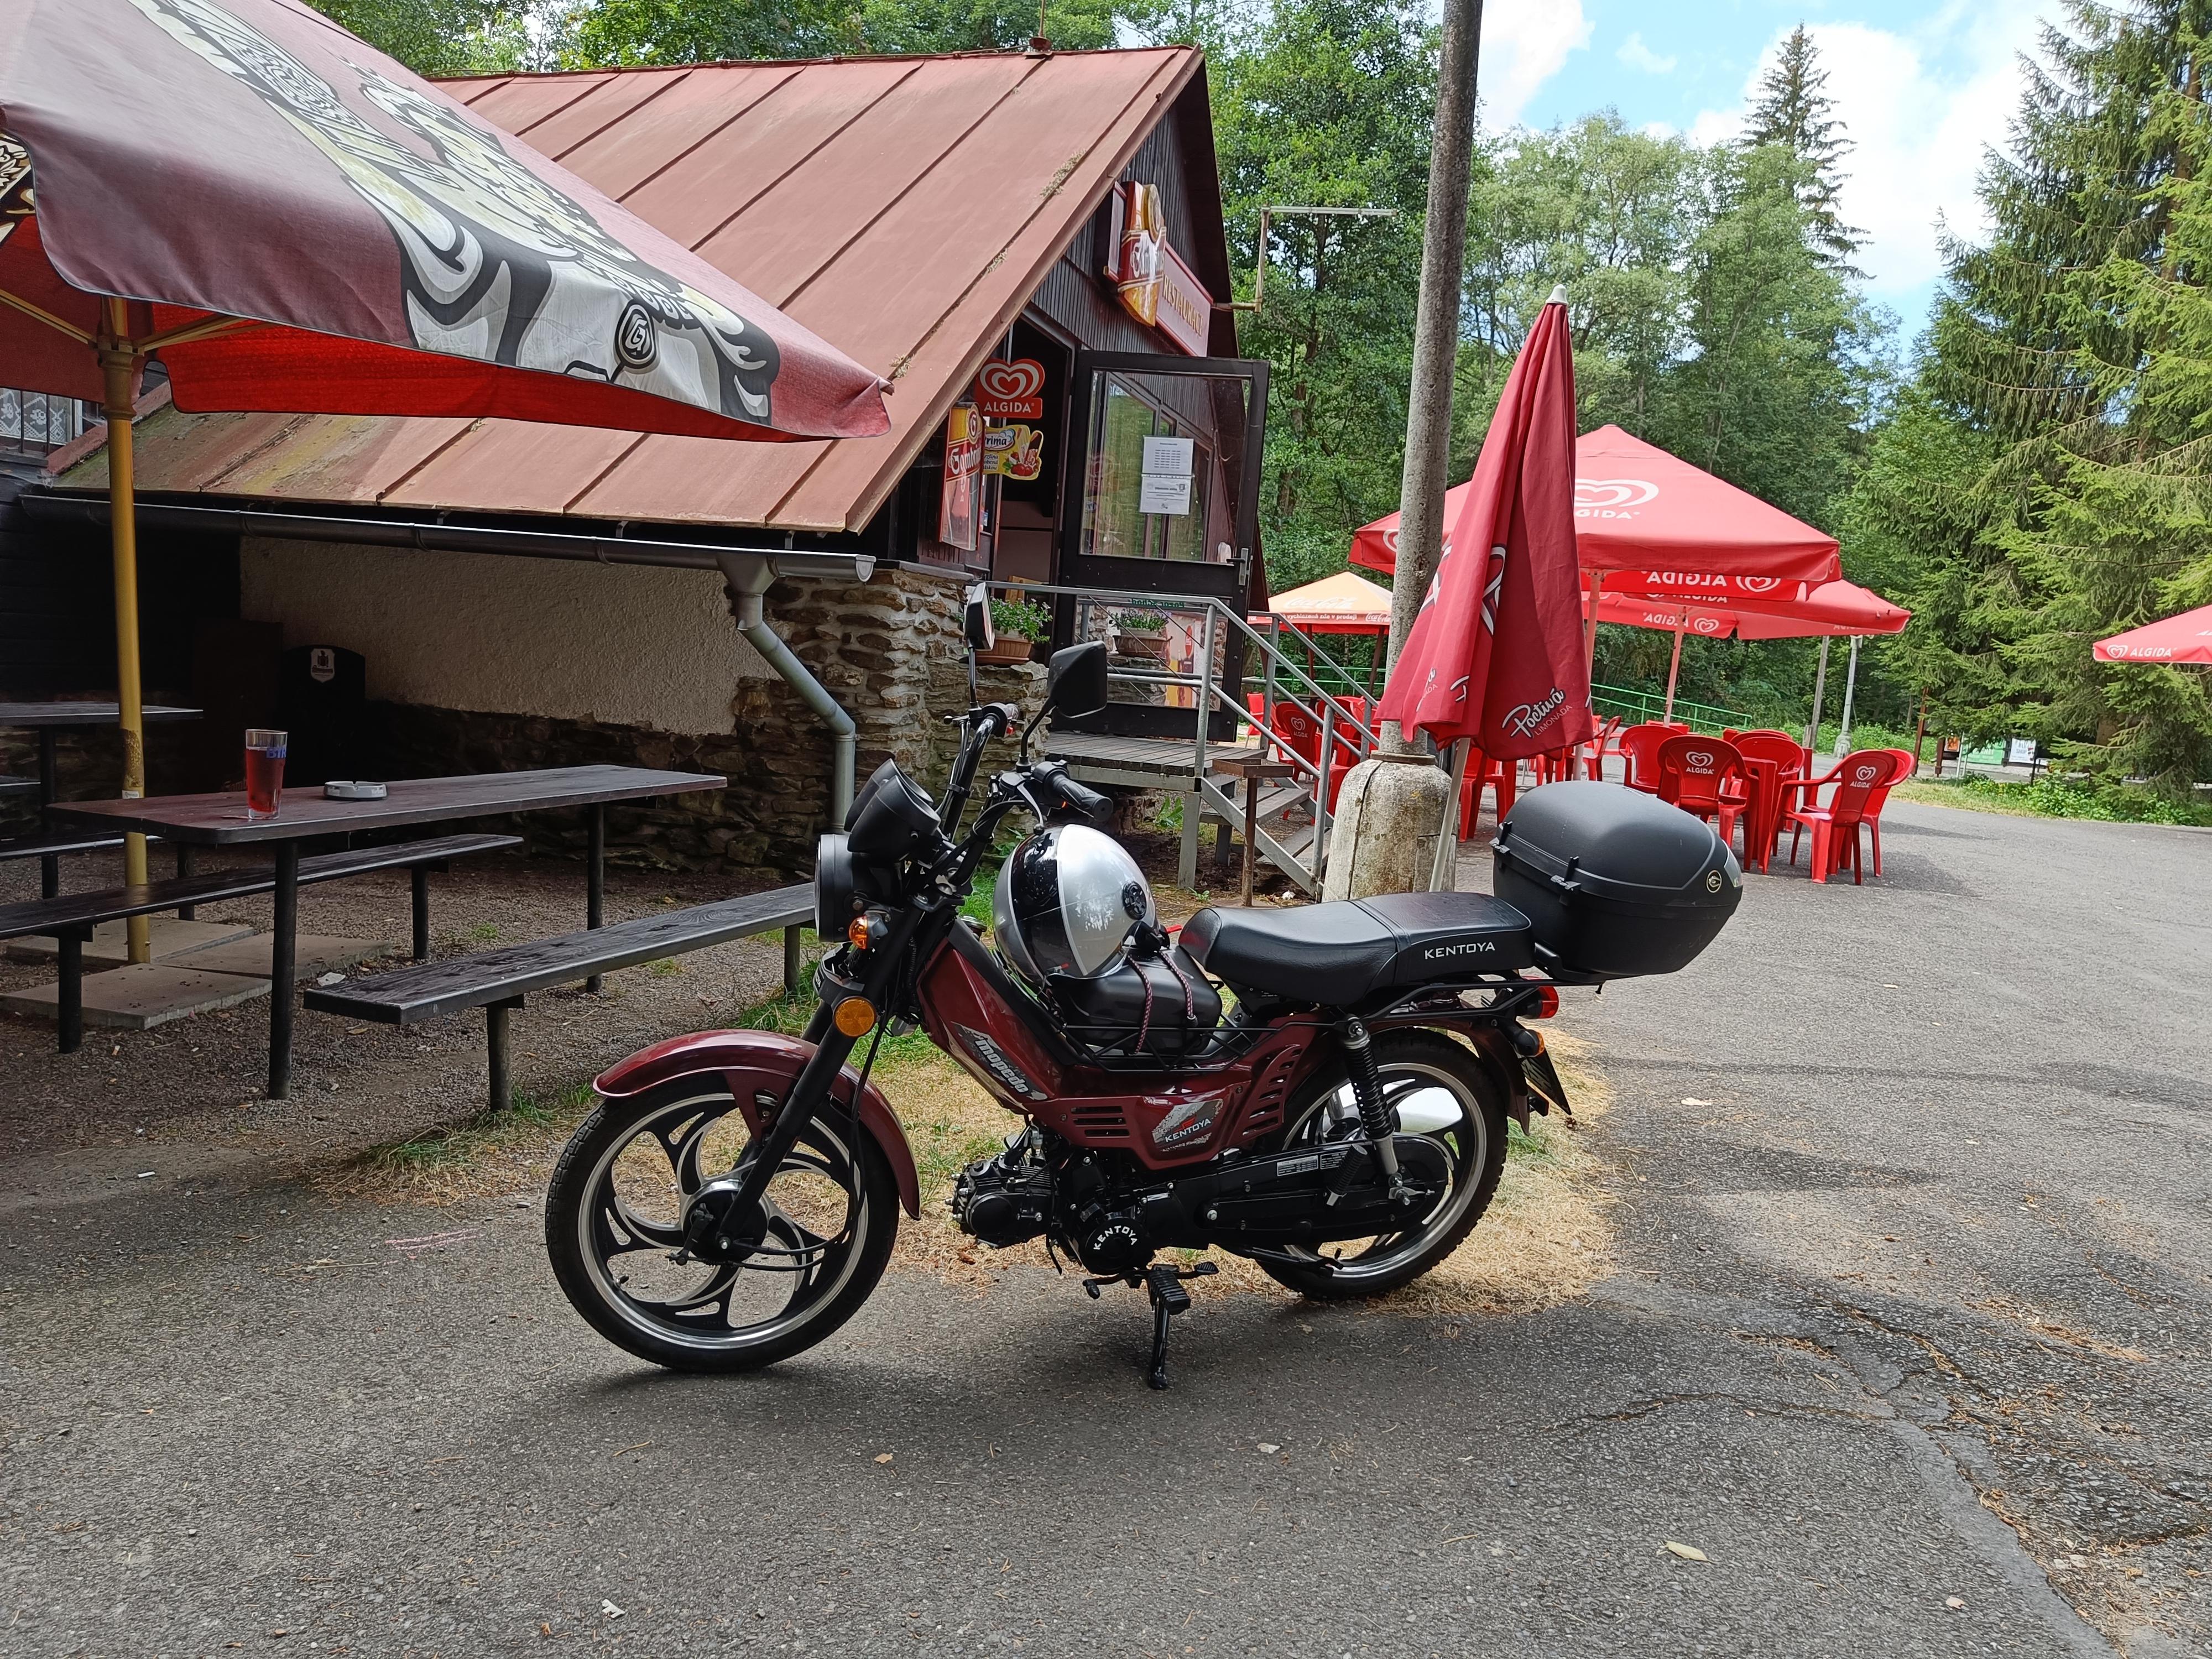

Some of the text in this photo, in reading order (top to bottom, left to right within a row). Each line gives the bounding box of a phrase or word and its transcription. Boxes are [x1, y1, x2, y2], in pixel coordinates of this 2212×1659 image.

[1162, 274, 1203, 337] RESTAURACE
[984, 402, 1031, 413] ALGIDA
[985, 436, 1007, 446] rima
[1575, 509, 1632, 519] GIDA
[1672, 594, 1728, 603] GIDA
[2130, 648, 2172, 657] ALGIDA
[1502, 687, 1564, 738] Poctivá
[1533, 705, 1573, 736] LIMONÁDA
[267, 747, 286, 758] BIR
[1686, 766, 1713, 775] ALGIDA
[1425, 942, 1495, 960] KENTOYA
[975, 1040, 1029, 1093] mopedo
[1165, 1118, 1211, 1142] KENTOYA
[1093, 1225, 1138, 1250] KENTOYA
